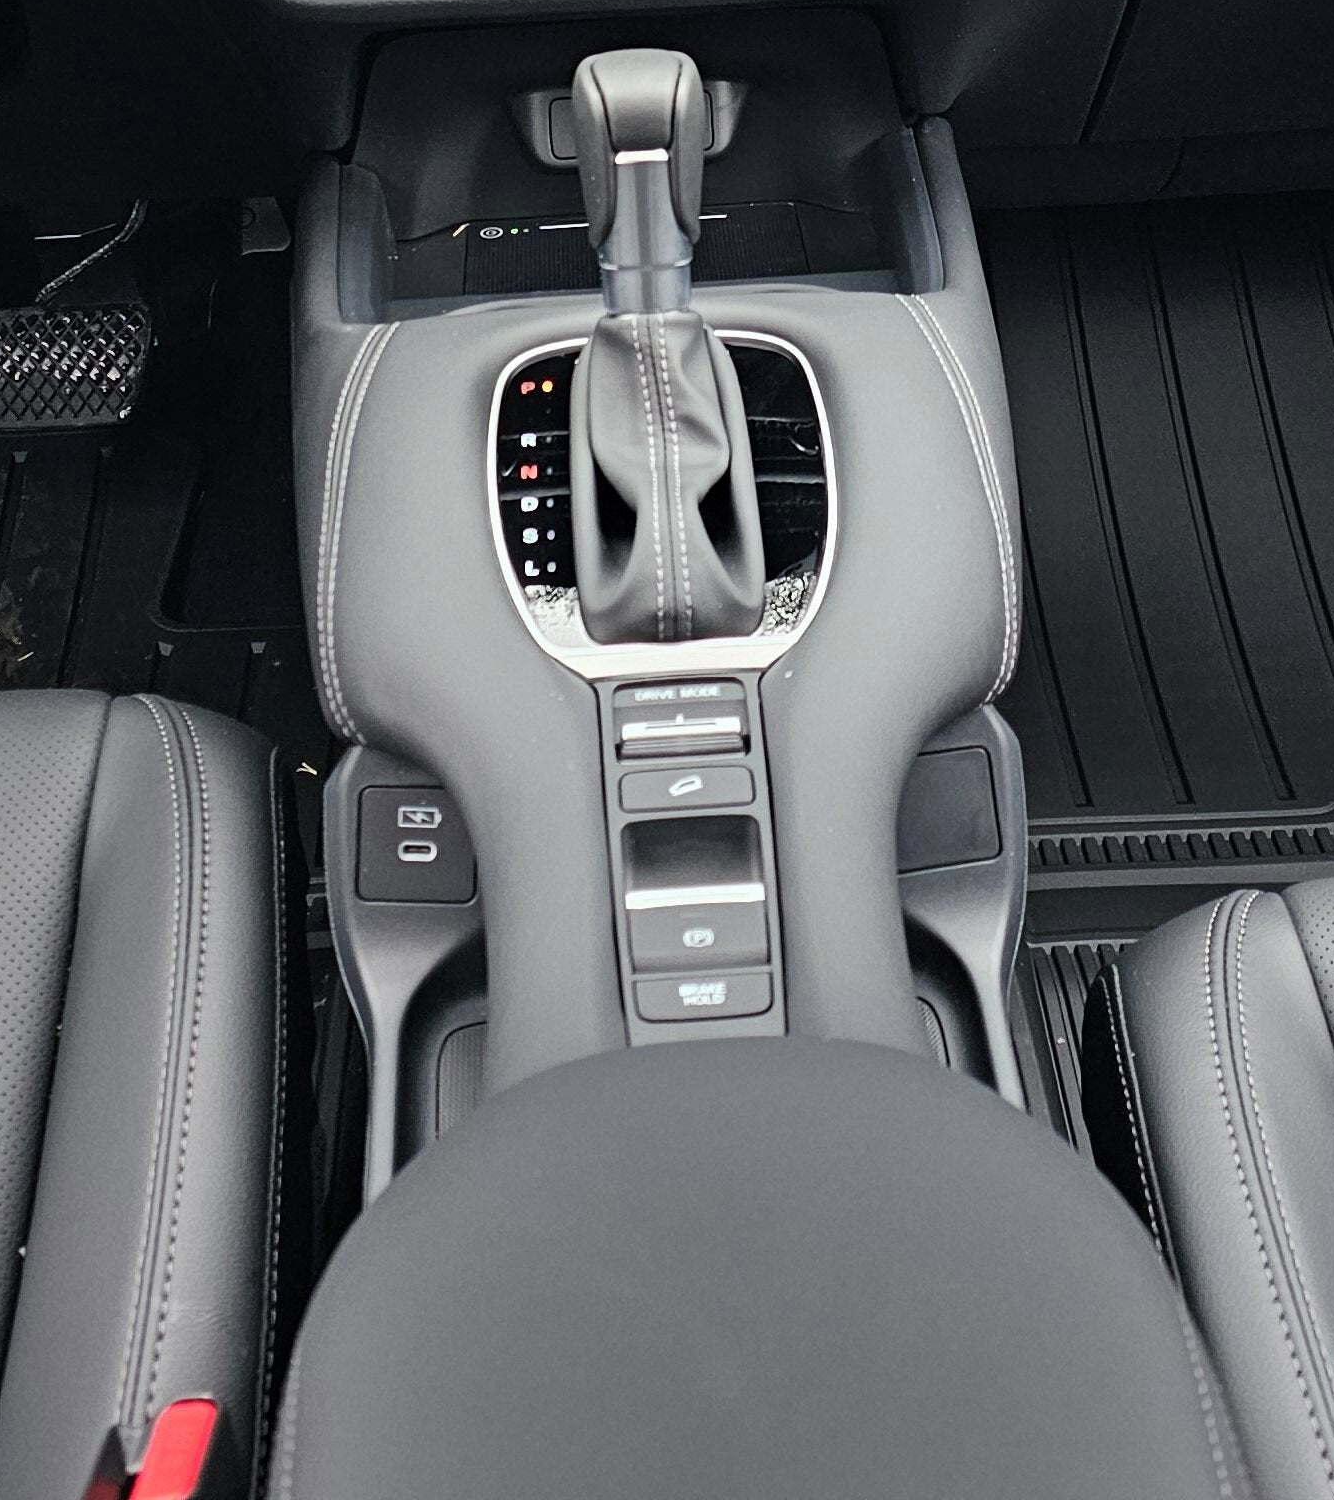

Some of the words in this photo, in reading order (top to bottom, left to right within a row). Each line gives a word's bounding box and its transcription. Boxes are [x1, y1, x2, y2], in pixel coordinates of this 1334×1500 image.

[521, 381, 535, 394] P
[521, 433, 536, 447] R
[521, 465, 538, 479] N
[521, 496, 538, 512] D
[523, 528, 538, 543] S
[524, 560, 540, 576] L
[635, 689, 677, 702] DRIVE
[680, 685, 721, 698] MODE
